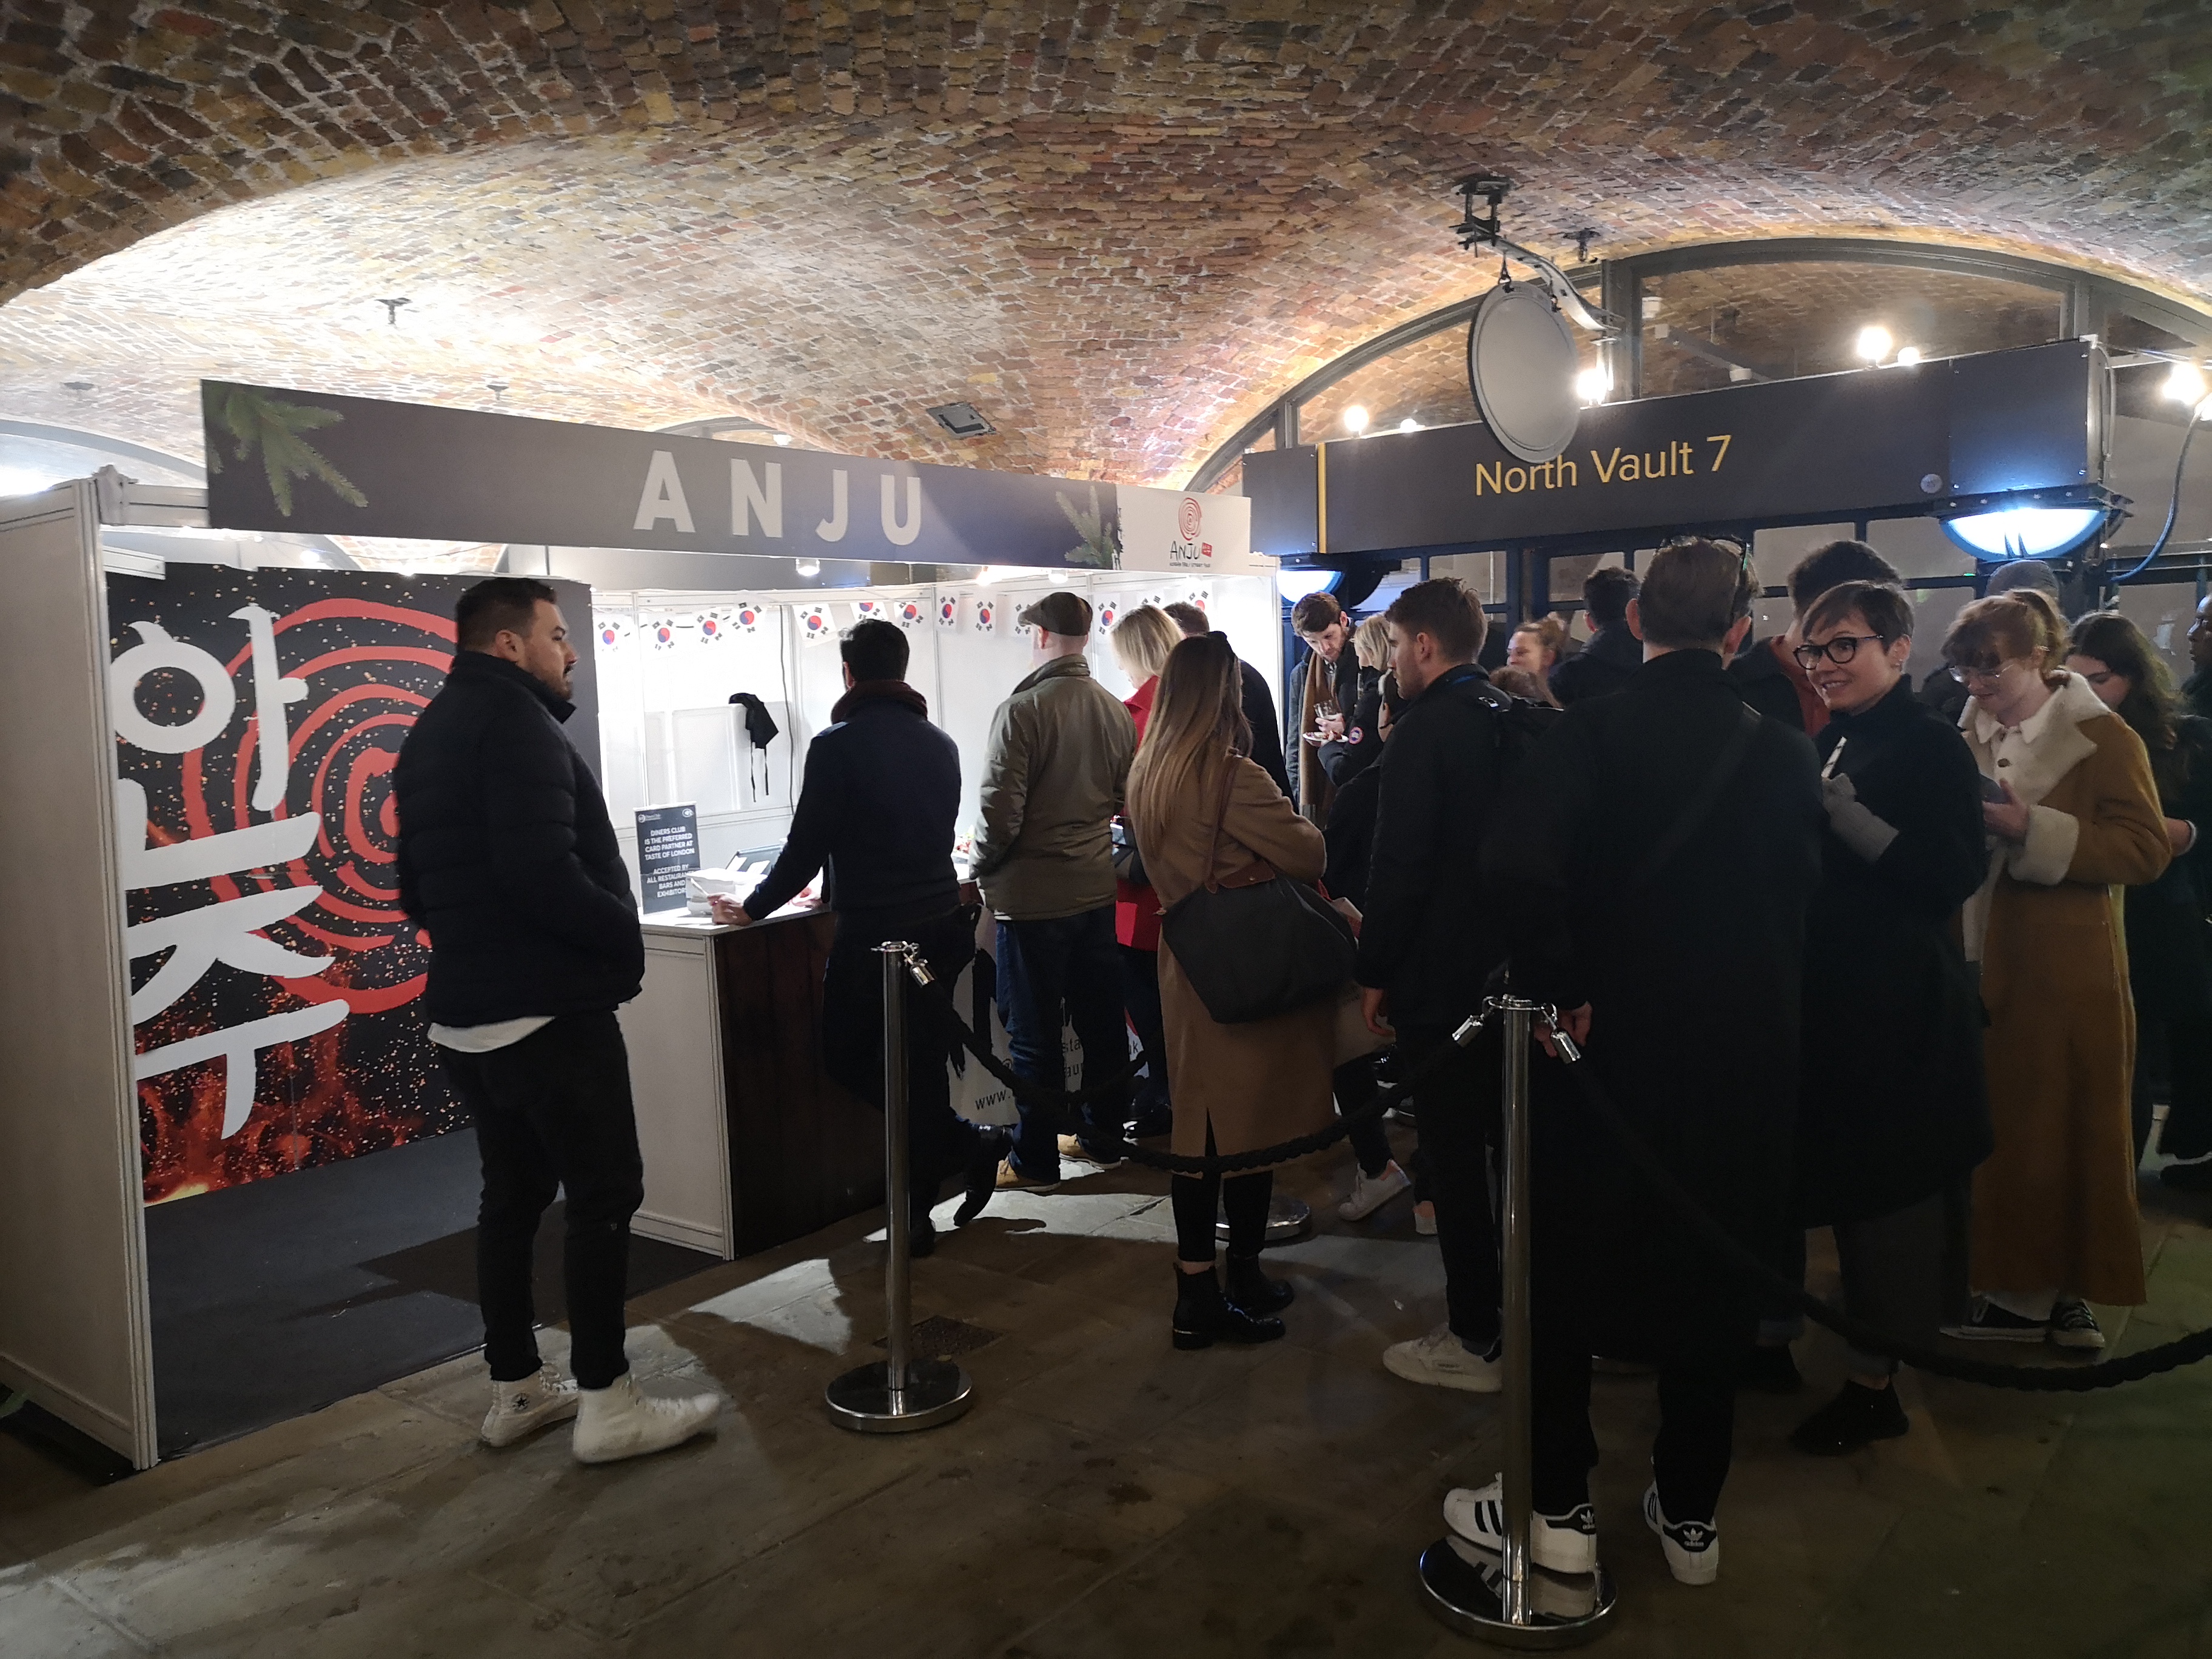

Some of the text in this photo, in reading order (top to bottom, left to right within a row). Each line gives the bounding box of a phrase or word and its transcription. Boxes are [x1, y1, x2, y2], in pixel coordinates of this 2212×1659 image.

[1476, 435, 1732, 496] North Vault 7
[633, 450, 921, 545] ANJU
[650, 828, 671, 837] DINERS
[662, 833, 692, 842] PREFERRED
[662, 842, 686, 850] PARTNER
[671, 848, 695, 857] LONDON
[653, 865, 681, 874] ACCEPTED
[659, 881, 673, 890] BARS
